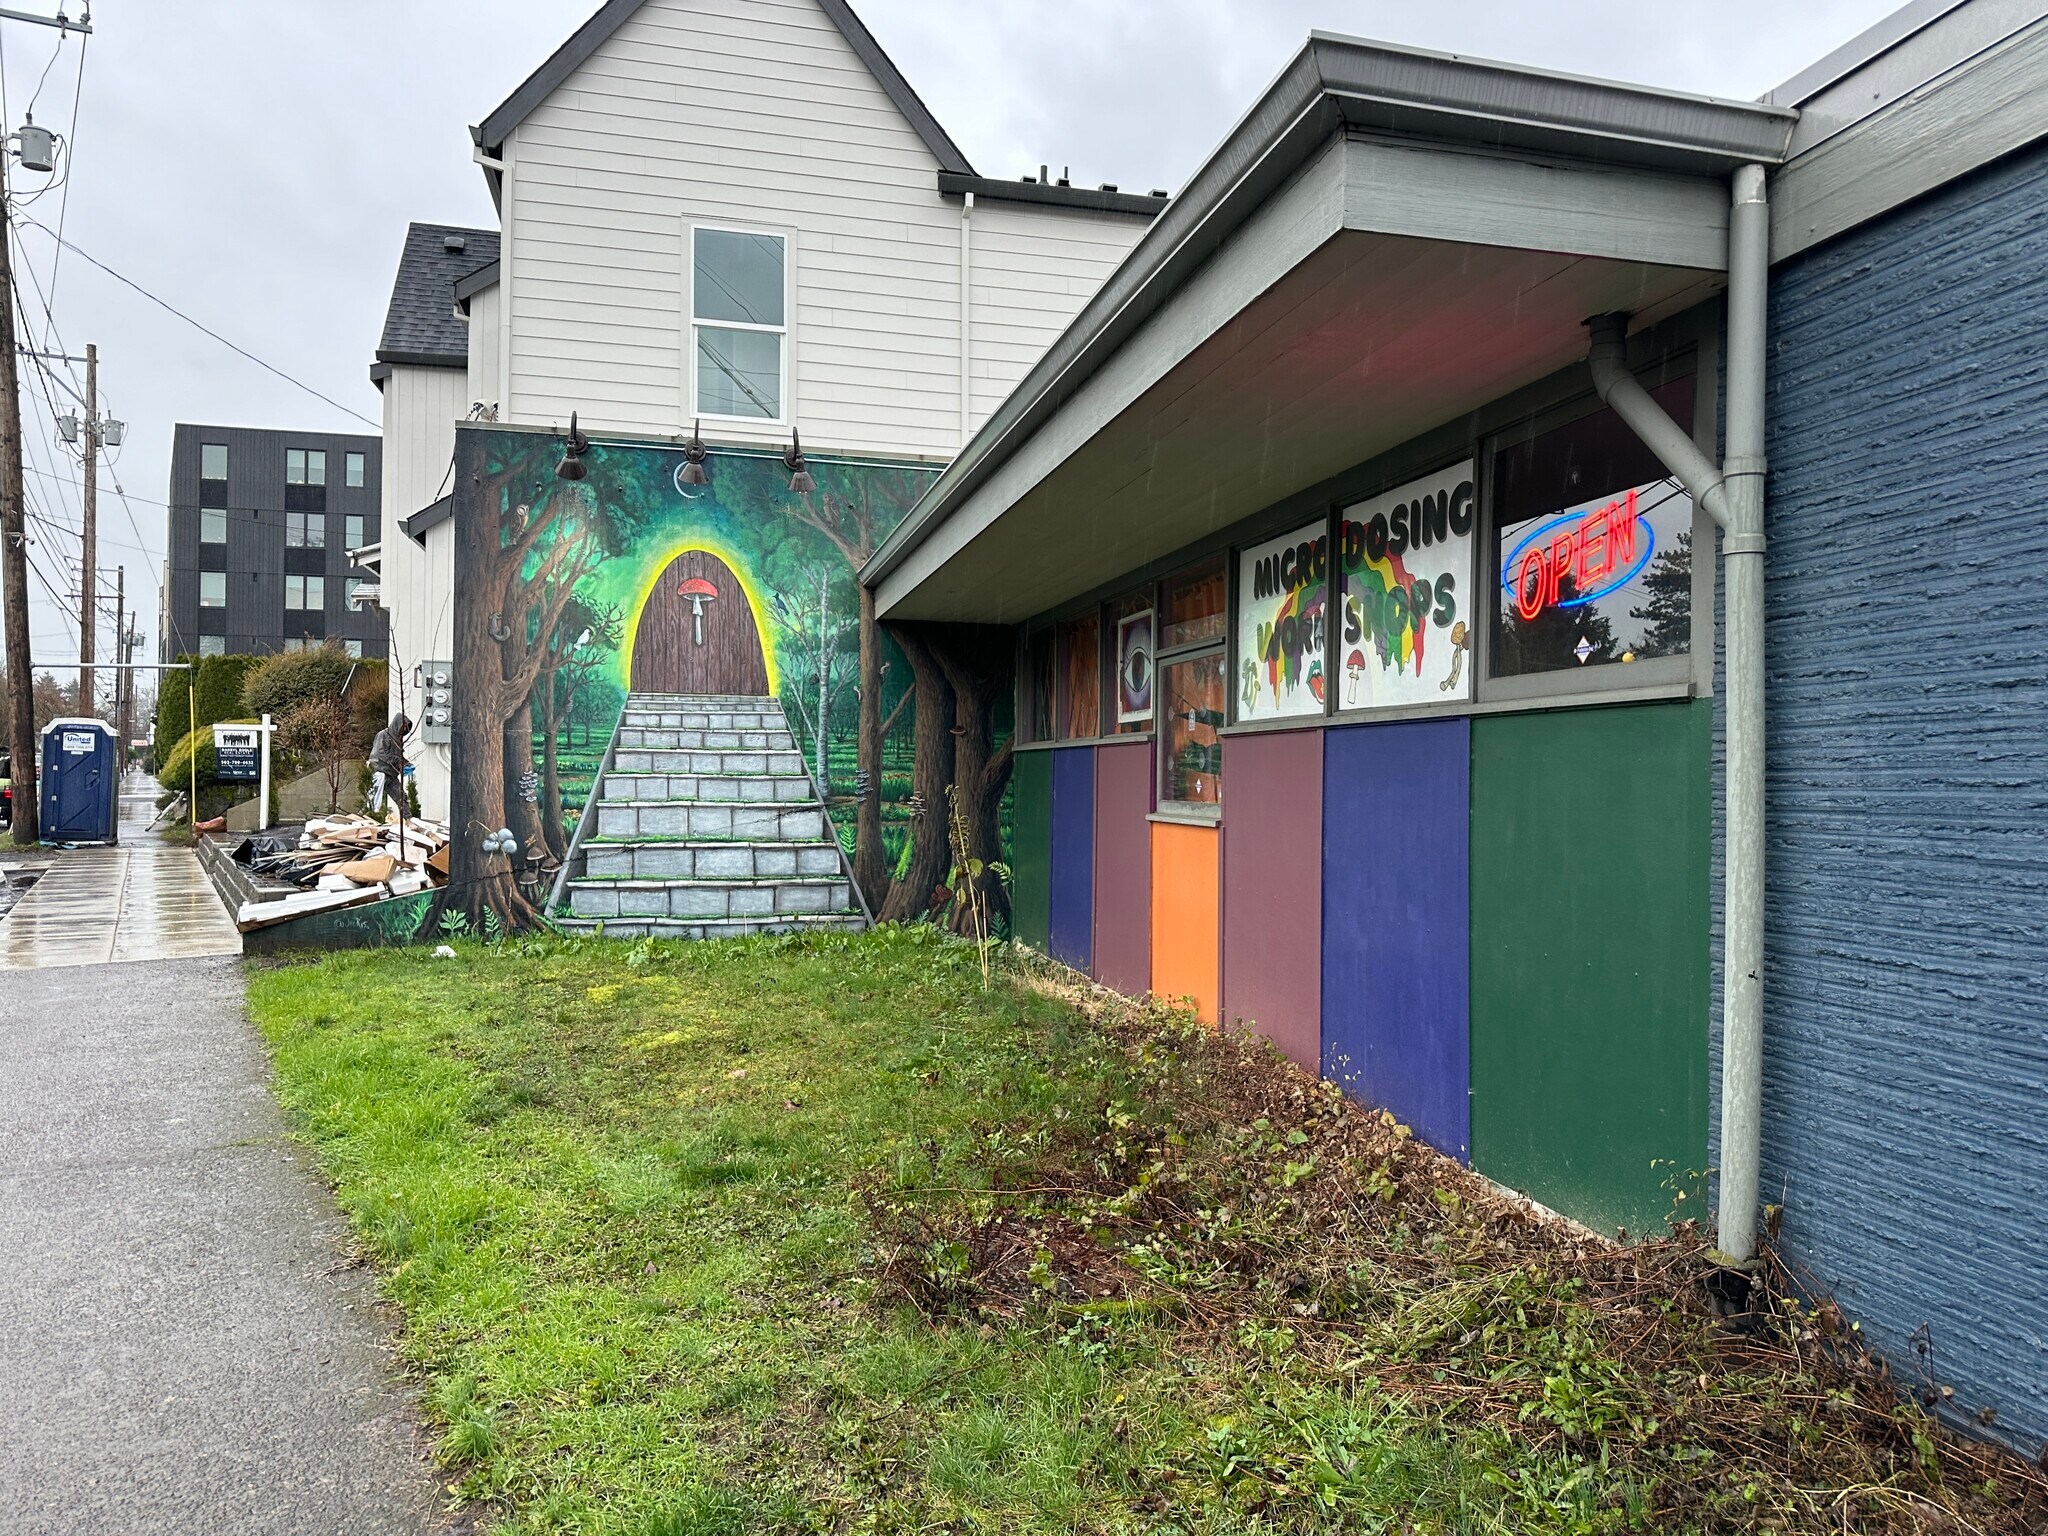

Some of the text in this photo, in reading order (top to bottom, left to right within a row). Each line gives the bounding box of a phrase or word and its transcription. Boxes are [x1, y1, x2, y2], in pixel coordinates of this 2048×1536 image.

[1254, 481, 1473, 600] MICRO DOSING
[1516, 488, 1637, 619] OPEN
[1345, 572, 1456, 645] SHOPS
